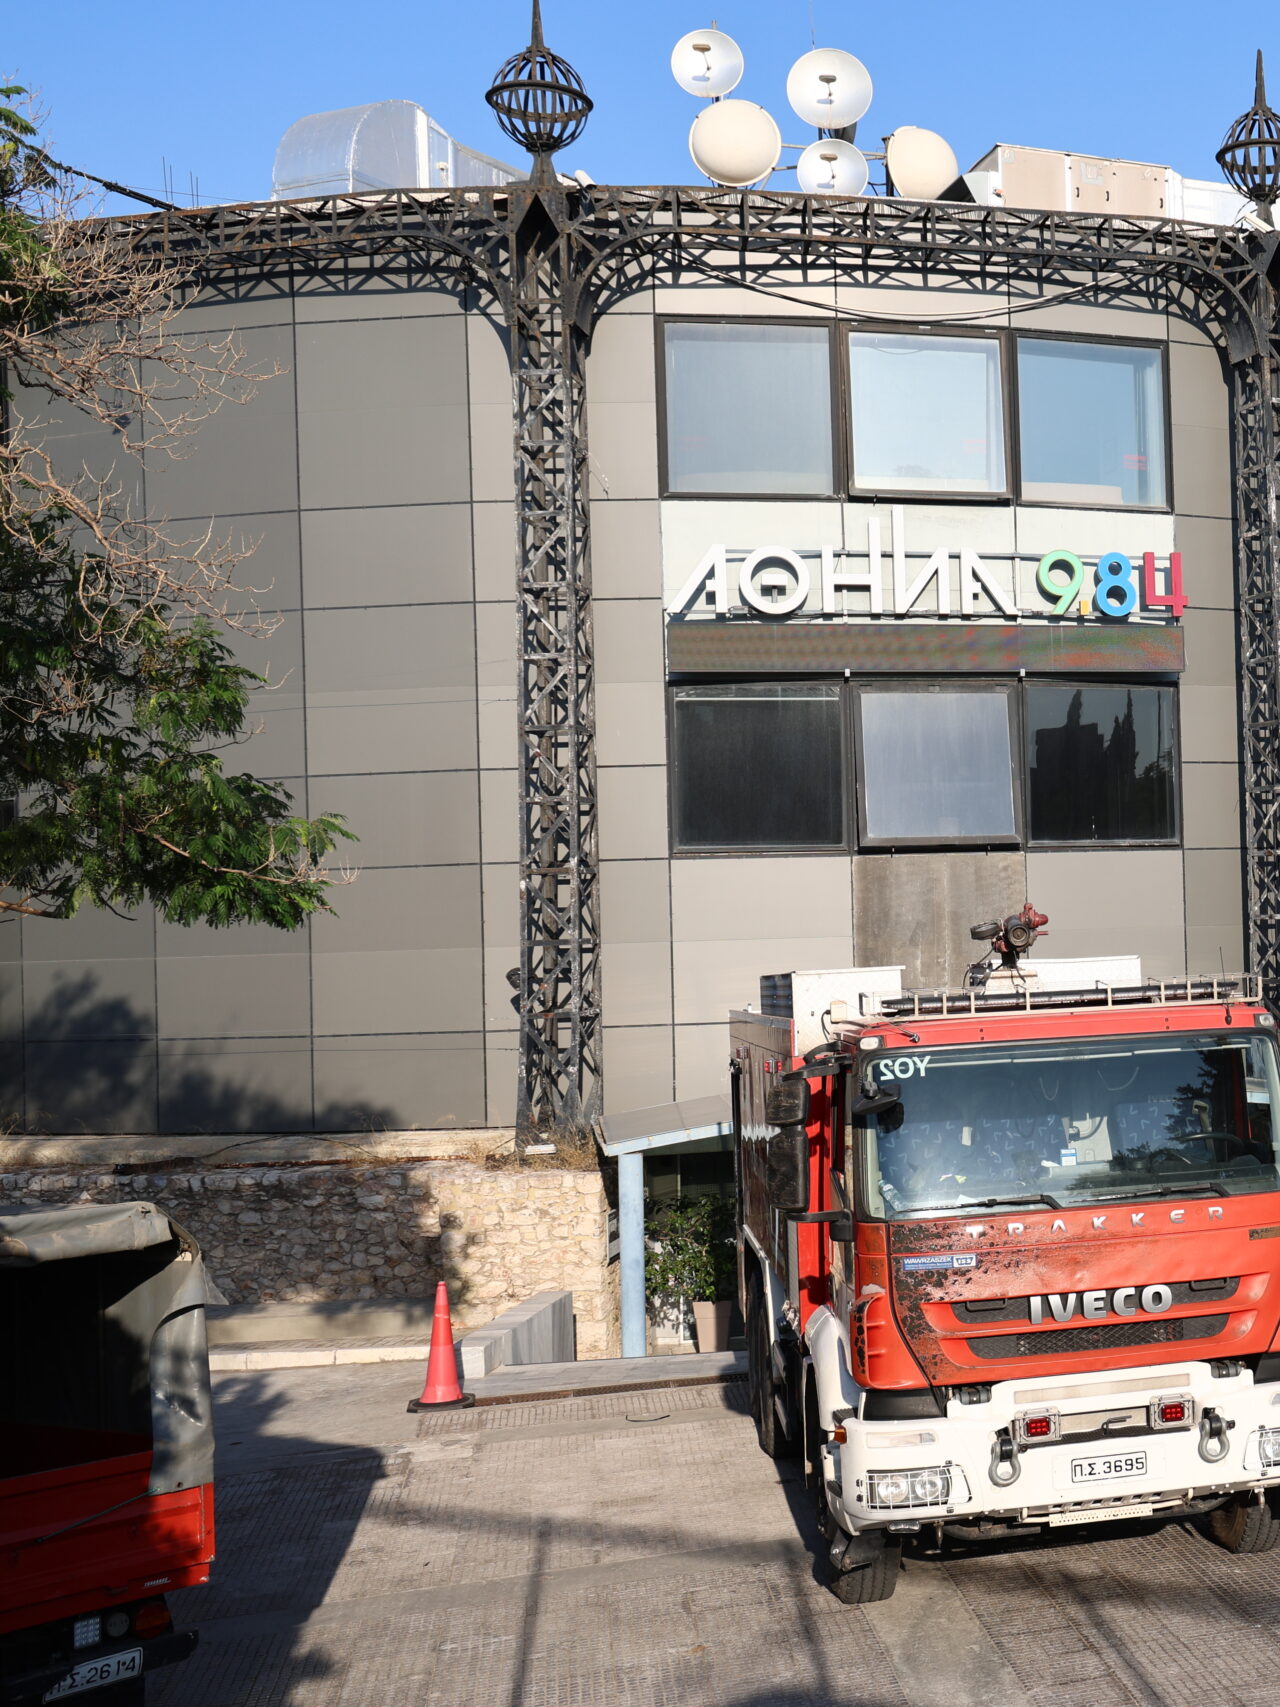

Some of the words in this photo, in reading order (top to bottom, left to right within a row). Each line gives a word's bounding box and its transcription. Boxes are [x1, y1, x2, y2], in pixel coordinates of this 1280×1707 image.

[1037, 550, 1188, 618] 9.84
[966, 1206, 1223, 1239] TRAKKER
[1028, 1284, 1172, 1325] IVECO
